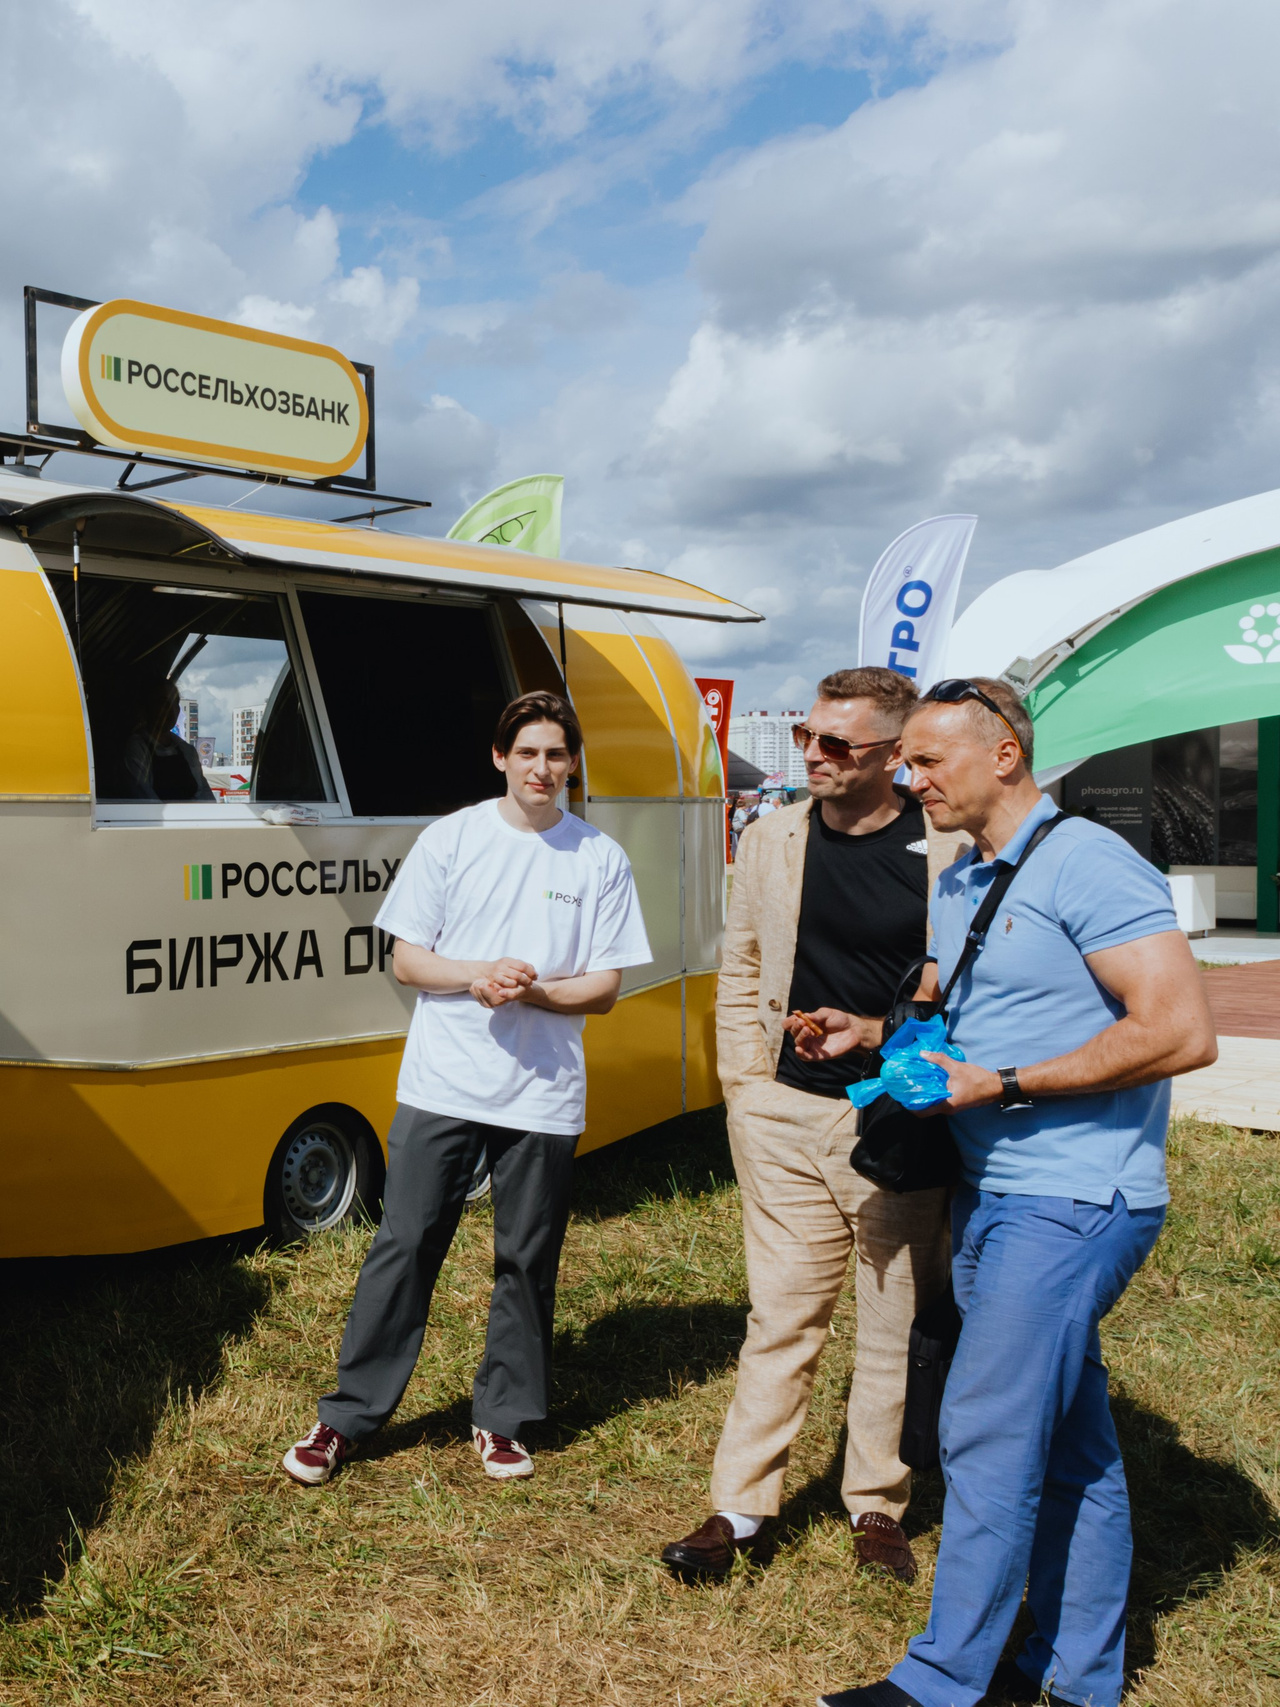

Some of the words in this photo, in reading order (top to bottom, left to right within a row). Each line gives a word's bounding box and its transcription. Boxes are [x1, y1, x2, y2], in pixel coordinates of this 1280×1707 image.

[128, 359, 350, 426] РОССЕЛЬХОЗБАНК
[1081, 786, 1143, 797] phosagro.ru
[221, 858, 402, 899] РОССЕЛЬХ
[126, 929, 324, 994] БИРЖА
